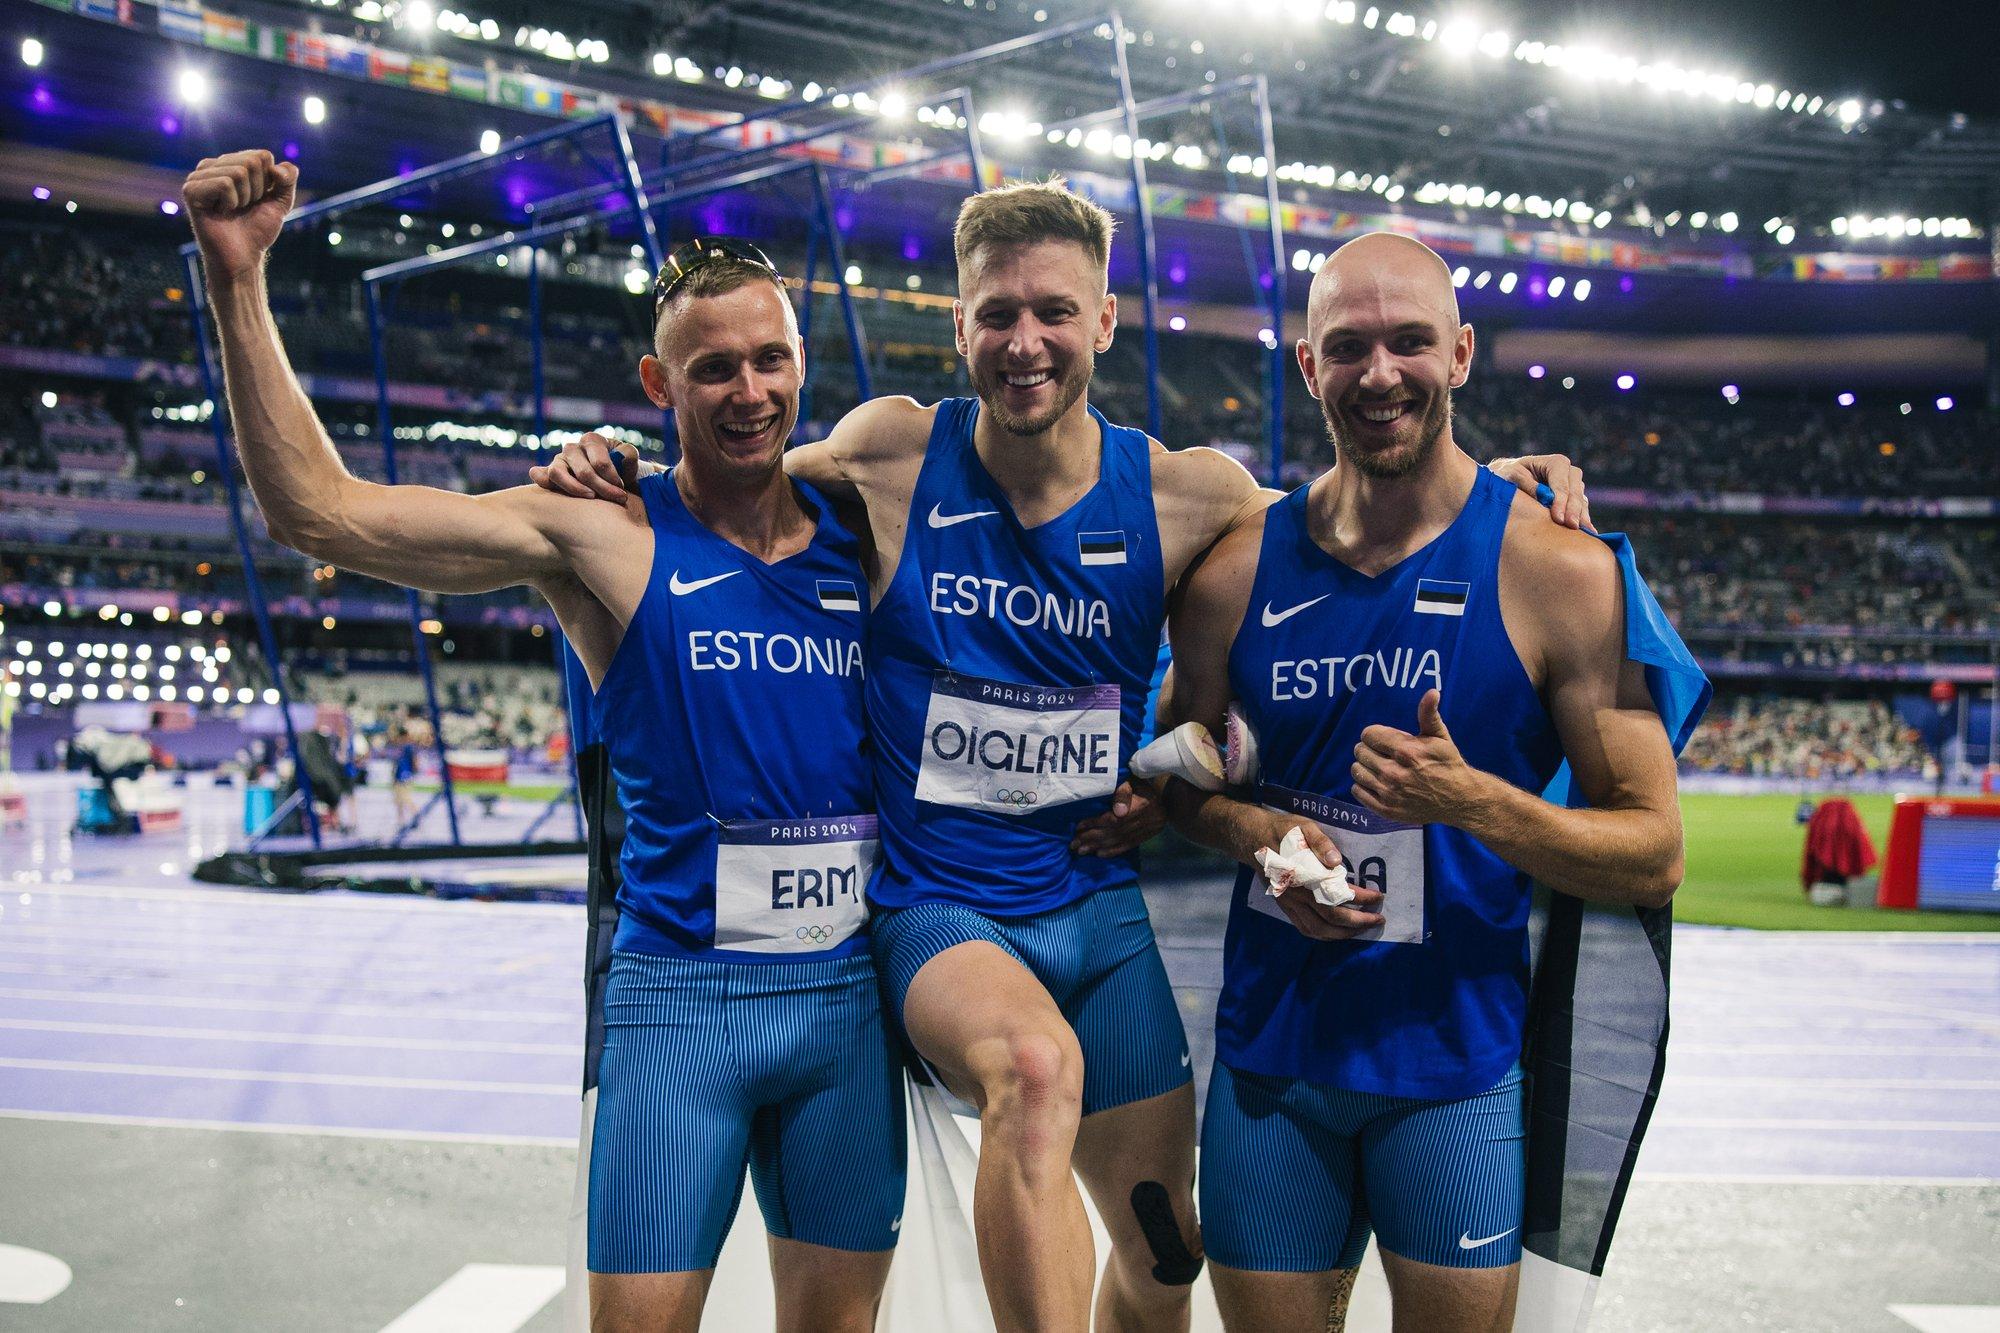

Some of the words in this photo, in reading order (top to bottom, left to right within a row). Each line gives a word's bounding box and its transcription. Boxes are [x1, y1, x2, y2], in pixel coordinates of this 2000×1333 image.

[931, 572, 1111, 638] ESTONIA
[689, 631, 865, 680] ESTONIA
[1272, 647, 1442, 701] ESTONIA
[983, 685, 1030, 703] PARIS
[1037, 693, 1075, 705] 2024
[931, 721, 1110, 774] OIGLANE
[771, 826, 817, 839] PARIS
[822, 823, 857, 837] 2024
[1293, 798, 1329, 816] PARIS
[1332, 808, 1368, 827] 2024
[771, 864, 859, 910] ERM
